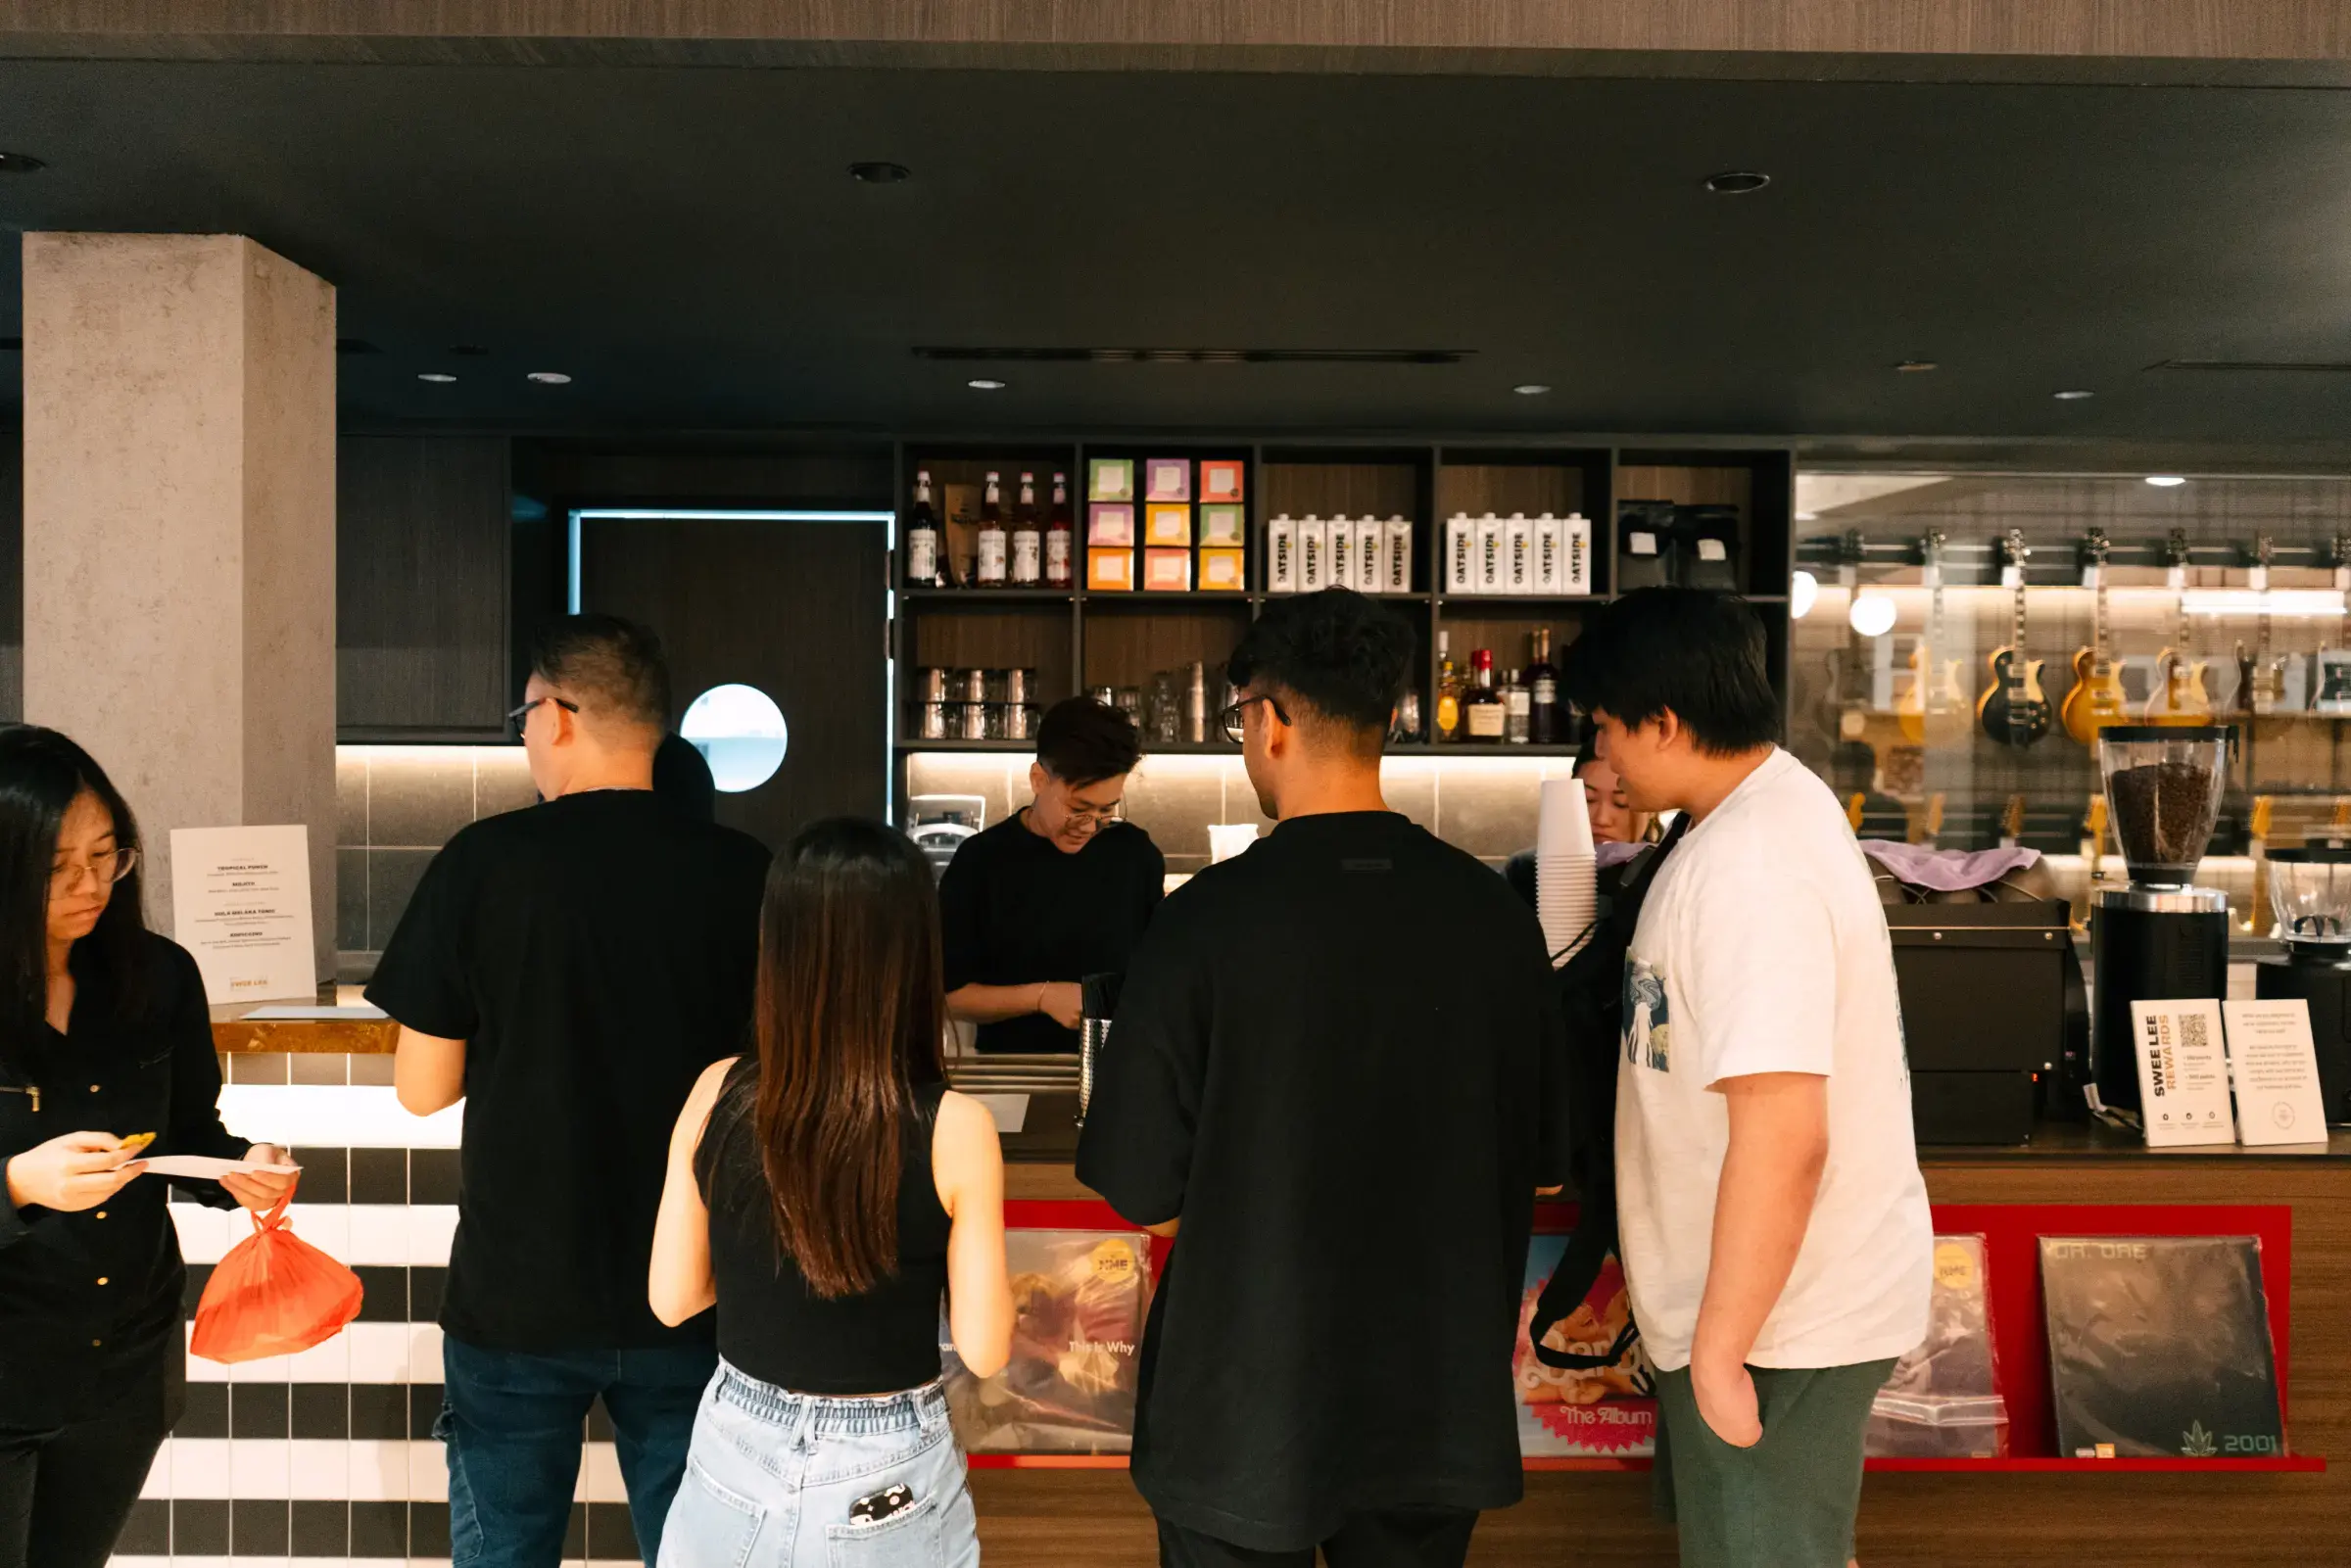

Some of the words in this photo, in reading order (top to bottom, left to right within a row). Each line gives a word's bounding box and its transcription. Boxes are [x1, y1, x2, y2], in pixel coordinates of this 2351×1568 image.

[1277, 533, 1288, 583] OATSIDE
[1307, 534, 1317, 585] OATSIDE
[1335, 534, 1345, 585] OATSIDE
[1364, 534, 1374, 586] OATSIDE
[1392, 534, 1403, 586] OATSIDE
[1456, 532, 1466, 584] OATSIDE
[1485, 532, 1495, 584] OATSIDE
[1513, 532, 1523, 584] OATSIDE
[1542, 532, 1553, 584] OATSIDE
[1571, 532, 1582, 584] OATSIDE
[2145, 1015, 2160, 1046] LEE
[2159, 1015, 2177, 1090] REWARDS
[2149, 1049, 2165, 1097] SWEE
[1069, 1341, 1093, 1353] This
[1107, 1341, 1134, 1355] Why
[1559, 1406, 1596, 1425] The
[1597, 1406, 1652, 1426] Album
[2224, 1435, 2277, 1452] 2001
